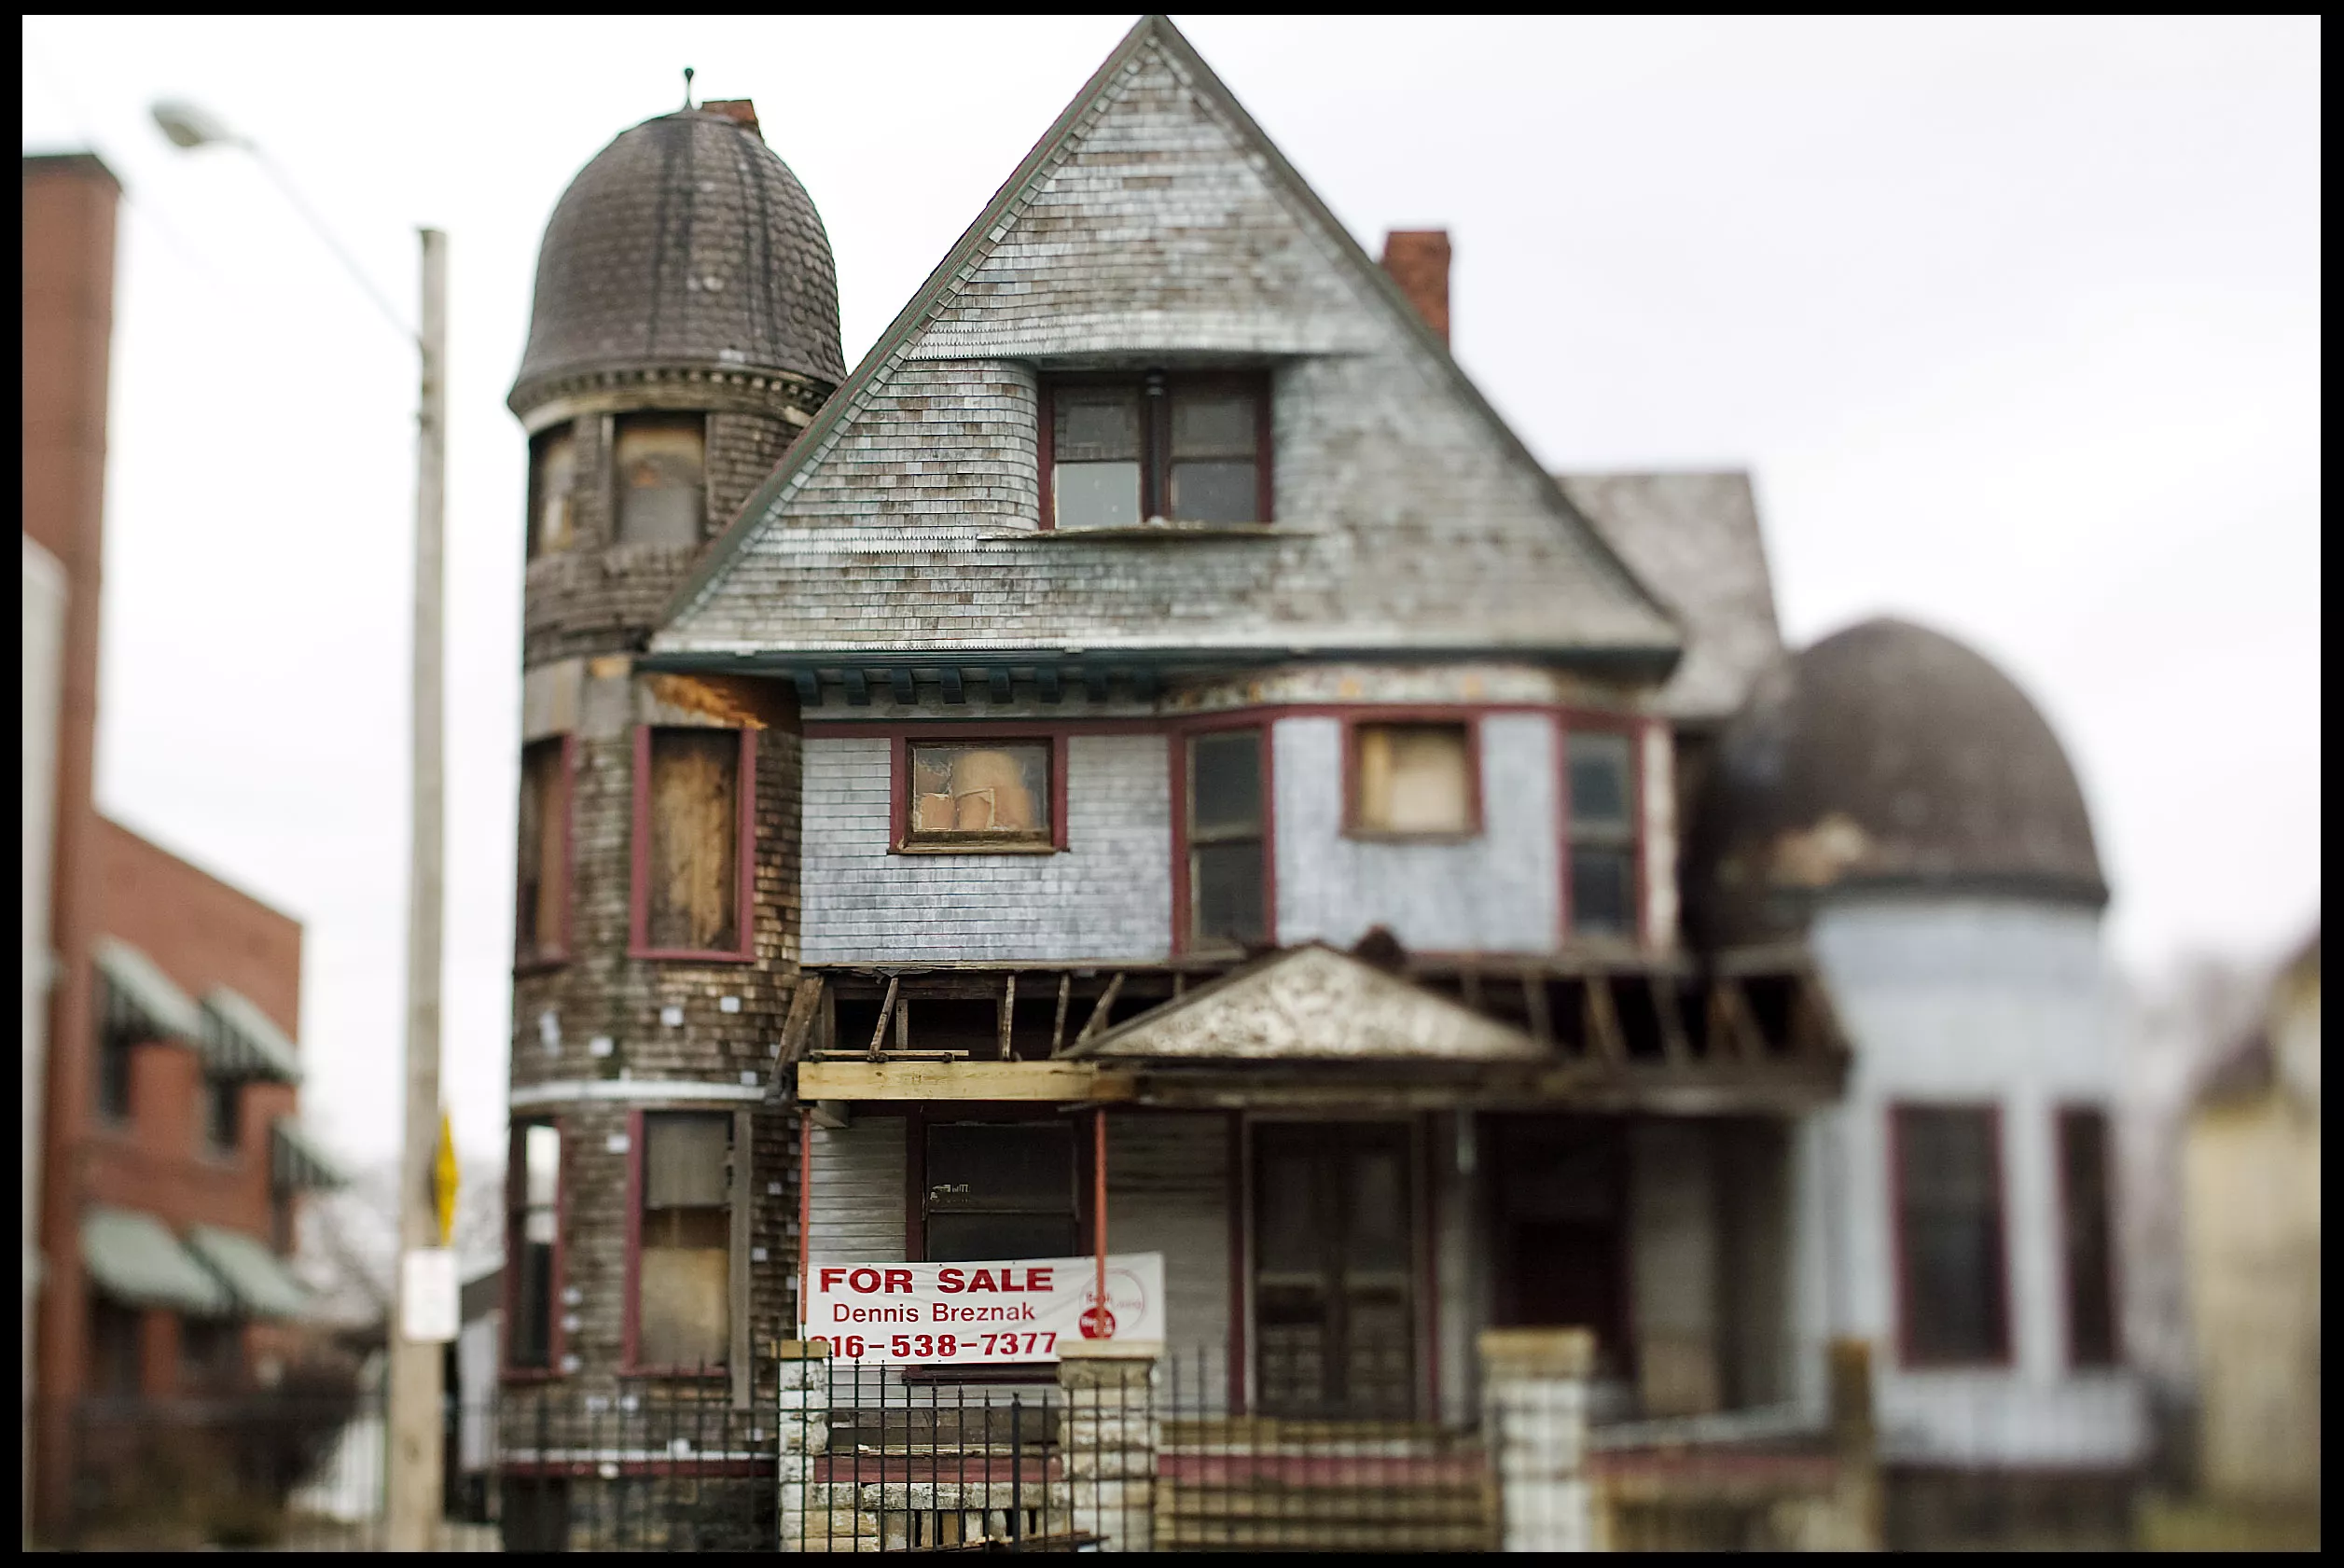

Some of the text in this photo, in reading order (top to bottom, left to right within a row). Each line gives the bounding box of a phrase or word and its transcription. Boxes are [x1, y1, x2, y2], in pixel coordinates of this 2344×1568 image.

[820, 1267, 1054, 1294] FOR SALE
[833, 1301, 1035, 1324] Dennis Breznak
[810, 1331, 1057, 1359] 16-538-7377
